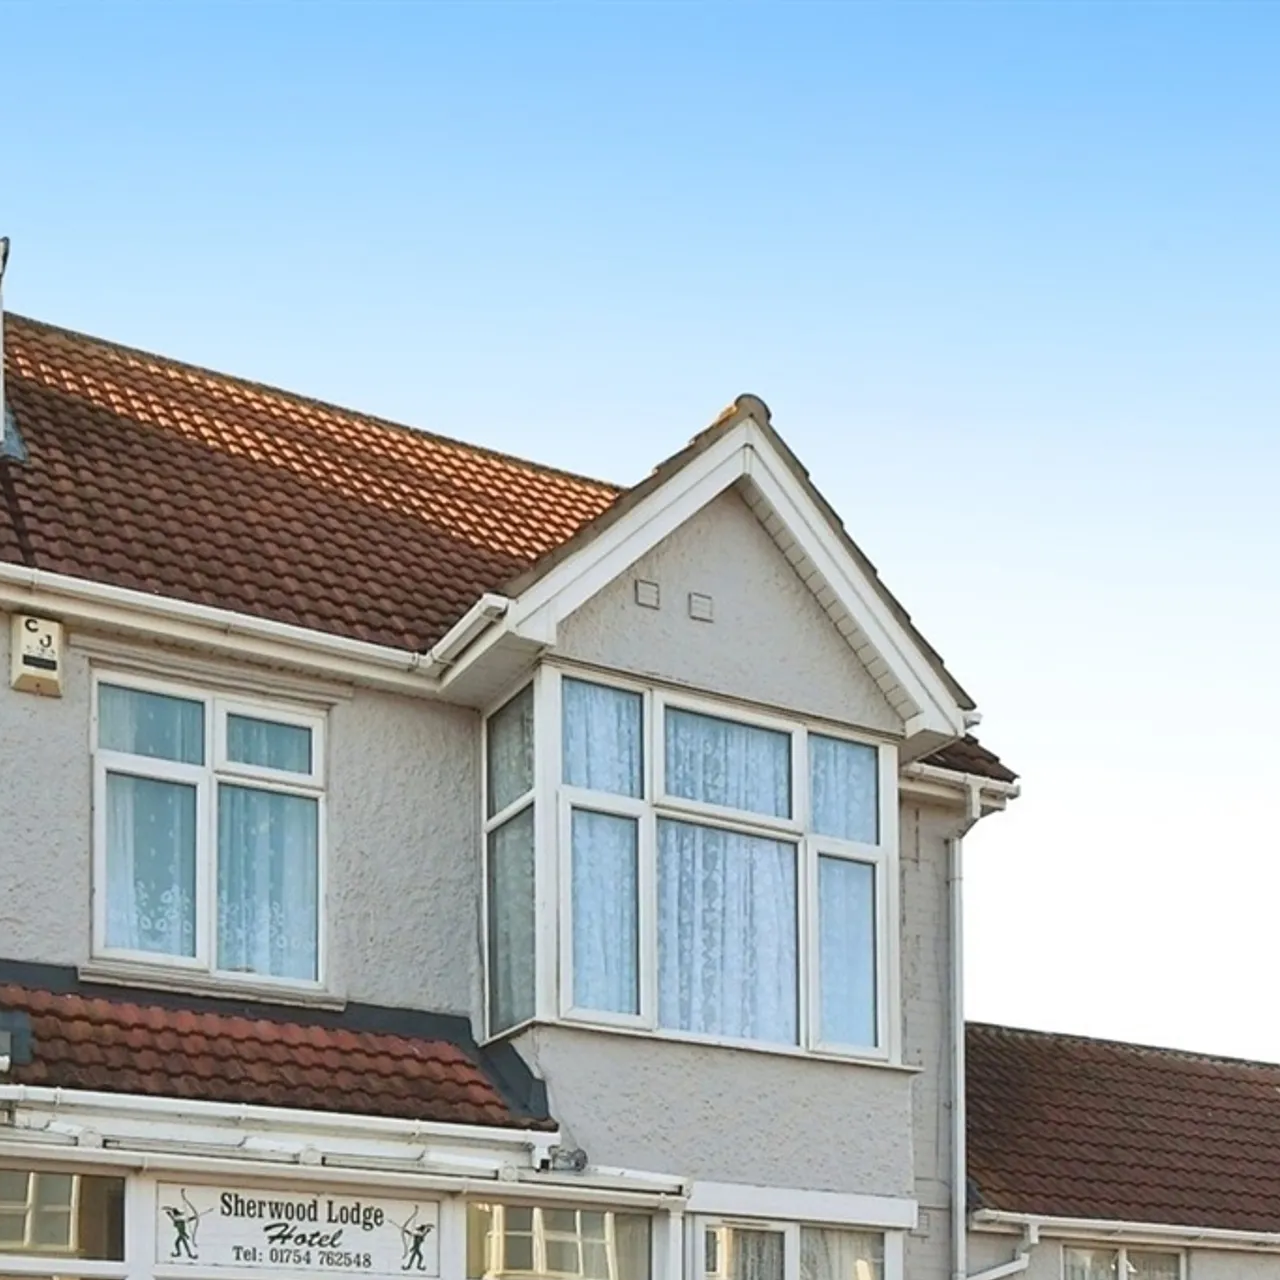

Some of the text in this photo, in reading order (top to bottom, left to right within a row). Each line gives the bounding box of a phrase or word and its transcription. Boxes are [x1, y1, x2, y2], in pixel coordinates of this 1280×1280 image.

[220, 1192, 385, 1231] Sherwood Lodge
[263, 1222, 343, 1248] Hotel
[232, 1245, 372, 1268] Tel: 01754 762548
